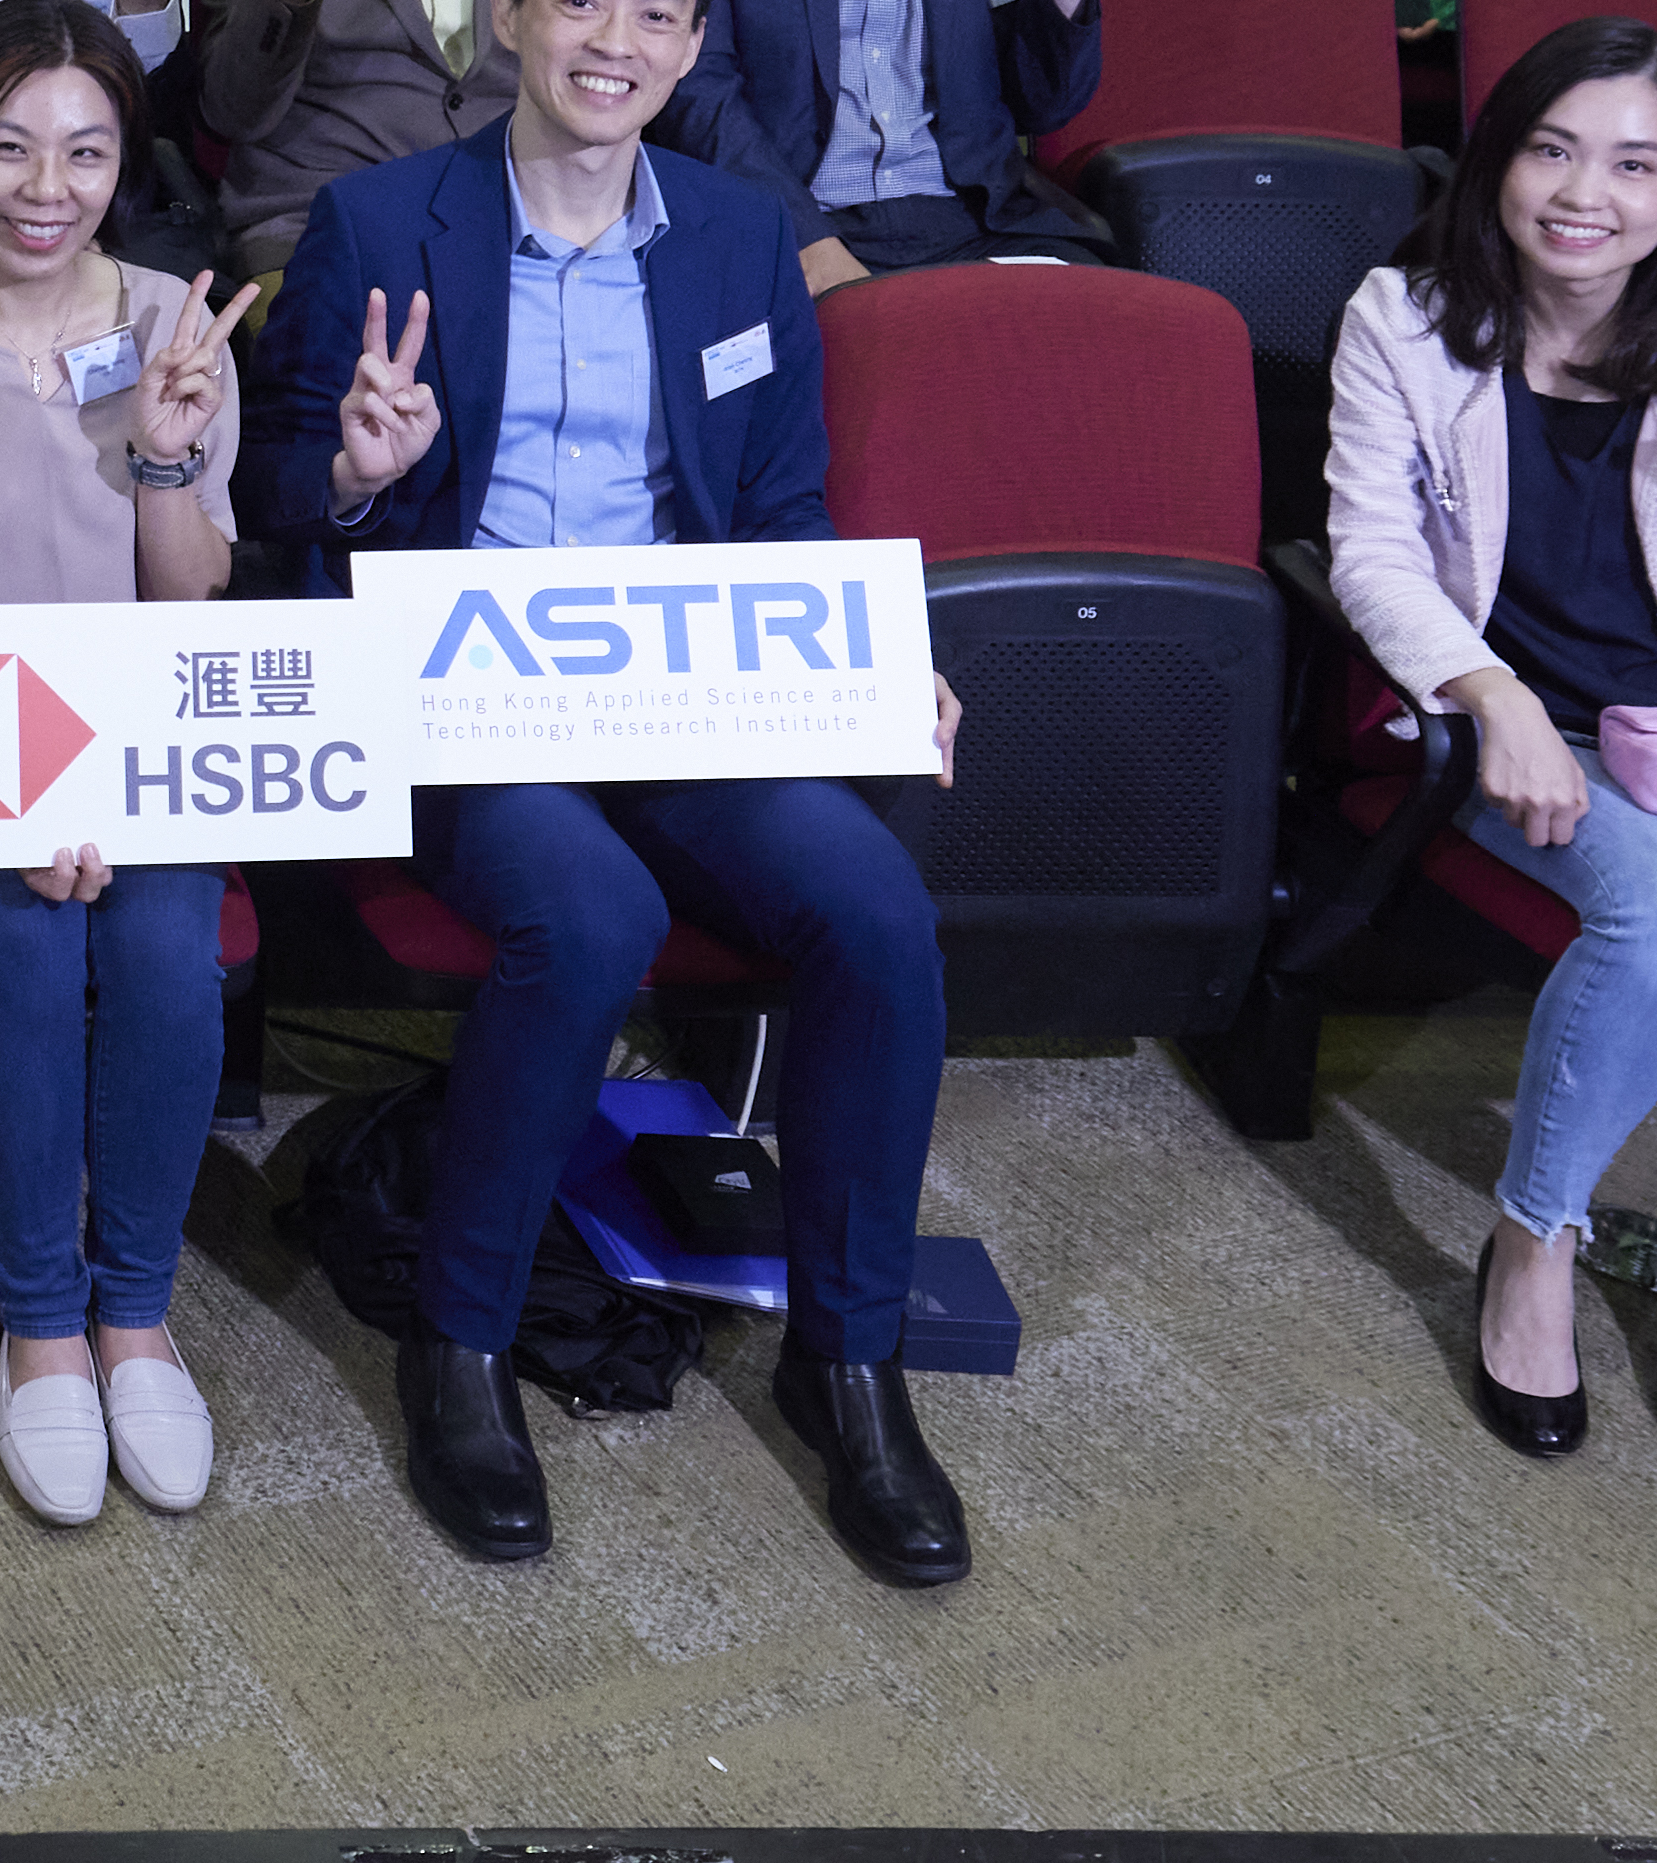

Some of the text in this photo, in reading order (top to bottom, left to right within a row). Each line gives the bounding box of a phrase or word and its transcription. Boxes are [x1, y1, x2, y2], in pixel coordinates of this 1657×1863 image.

[418, 580, 874, 680] ASTRI
[173, 648, 317, 720] 滙豐
[421, 685, 879, 715] Hong Kong Applied Science and
[422, 714, 859, 742] Technology Research Institute
[123, 740, 368, 817] HSBC
